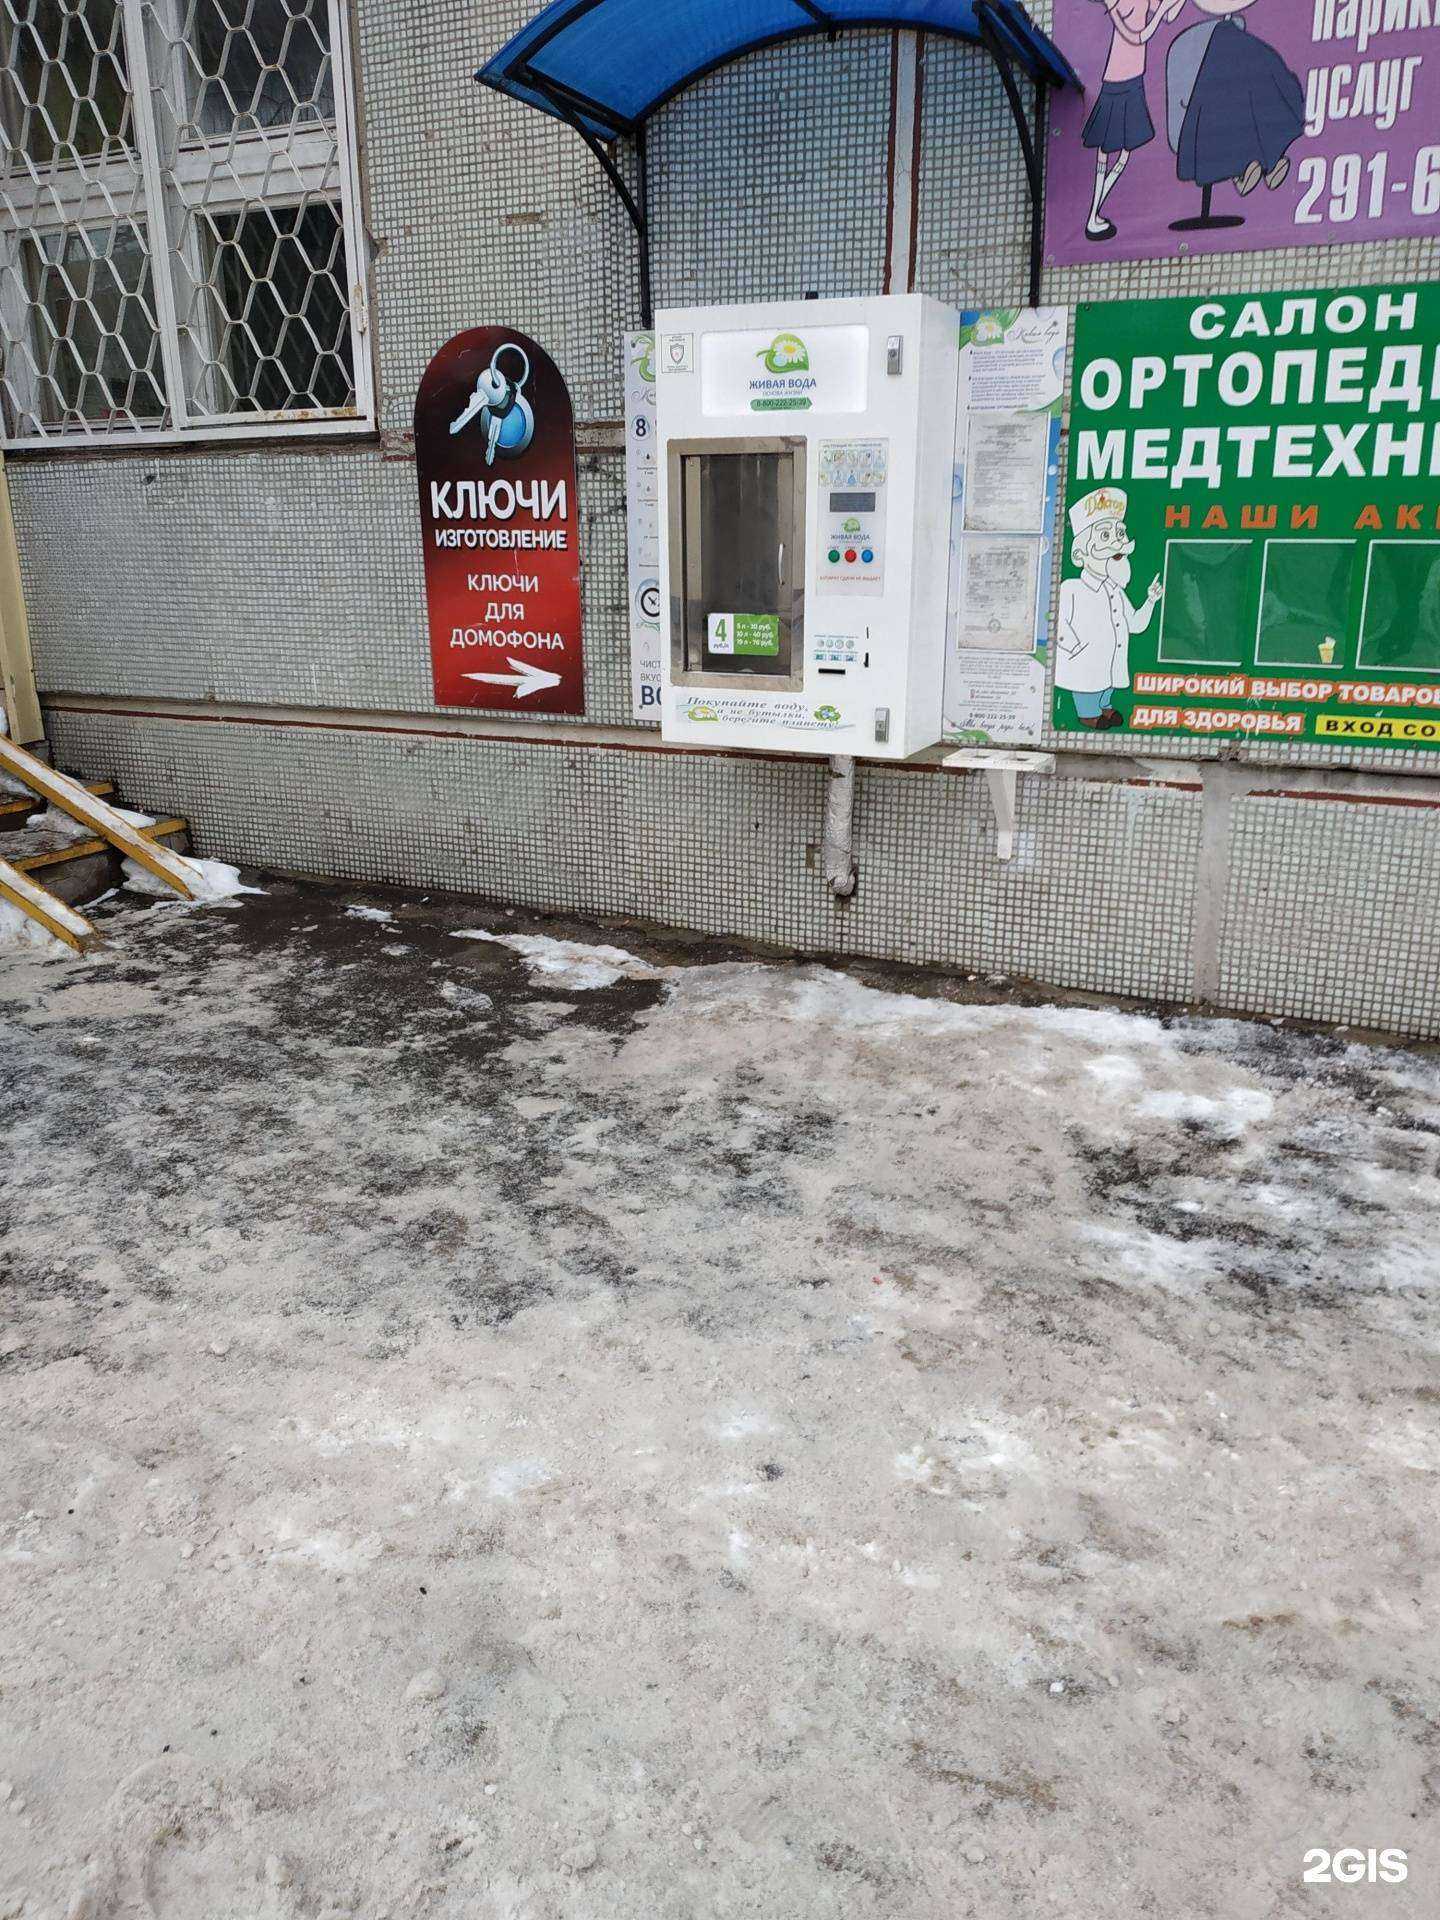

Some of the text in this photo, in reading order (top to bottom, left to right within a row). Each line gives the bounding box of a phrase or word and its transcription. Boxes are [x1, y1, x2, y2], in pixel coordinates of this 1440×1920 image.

[1304, 56, 1422, 137] услуг
[1189, 292, 1418, 340] САЛОН
[749, 378, 817, 390] ЖИВАЯ ВОДА
[1080, 344, 1440, 413] ОРТОПЕД
[635, 418, 647, 437] 8
[1076, 422, 1440, 489] МЕДТЕХН
[430, 479, 567, 520] КЛЮЧИ
[1165, 504, 1440, 530] НАШИ АК
[435, 529, 567, 549] ИЗГОТОВЛЕНИЕ
[467, 574, 539, 593] КЛЮЧИ
[485, 602, 524, 623] ДЛЯ
[450, 629, 565, 650] ДОМОФОНА
[715, 618, 727, 642] 4
[1136, 675, 1245, 695] ШИРОКИЙ
[1251, 680, 1332, 700] ВЫБОР
[1133, 707, 1301, 732] ДЛЯ ЗДОРОВЬЯ
[1326, 719, 1436, 738] ВХОД СО
